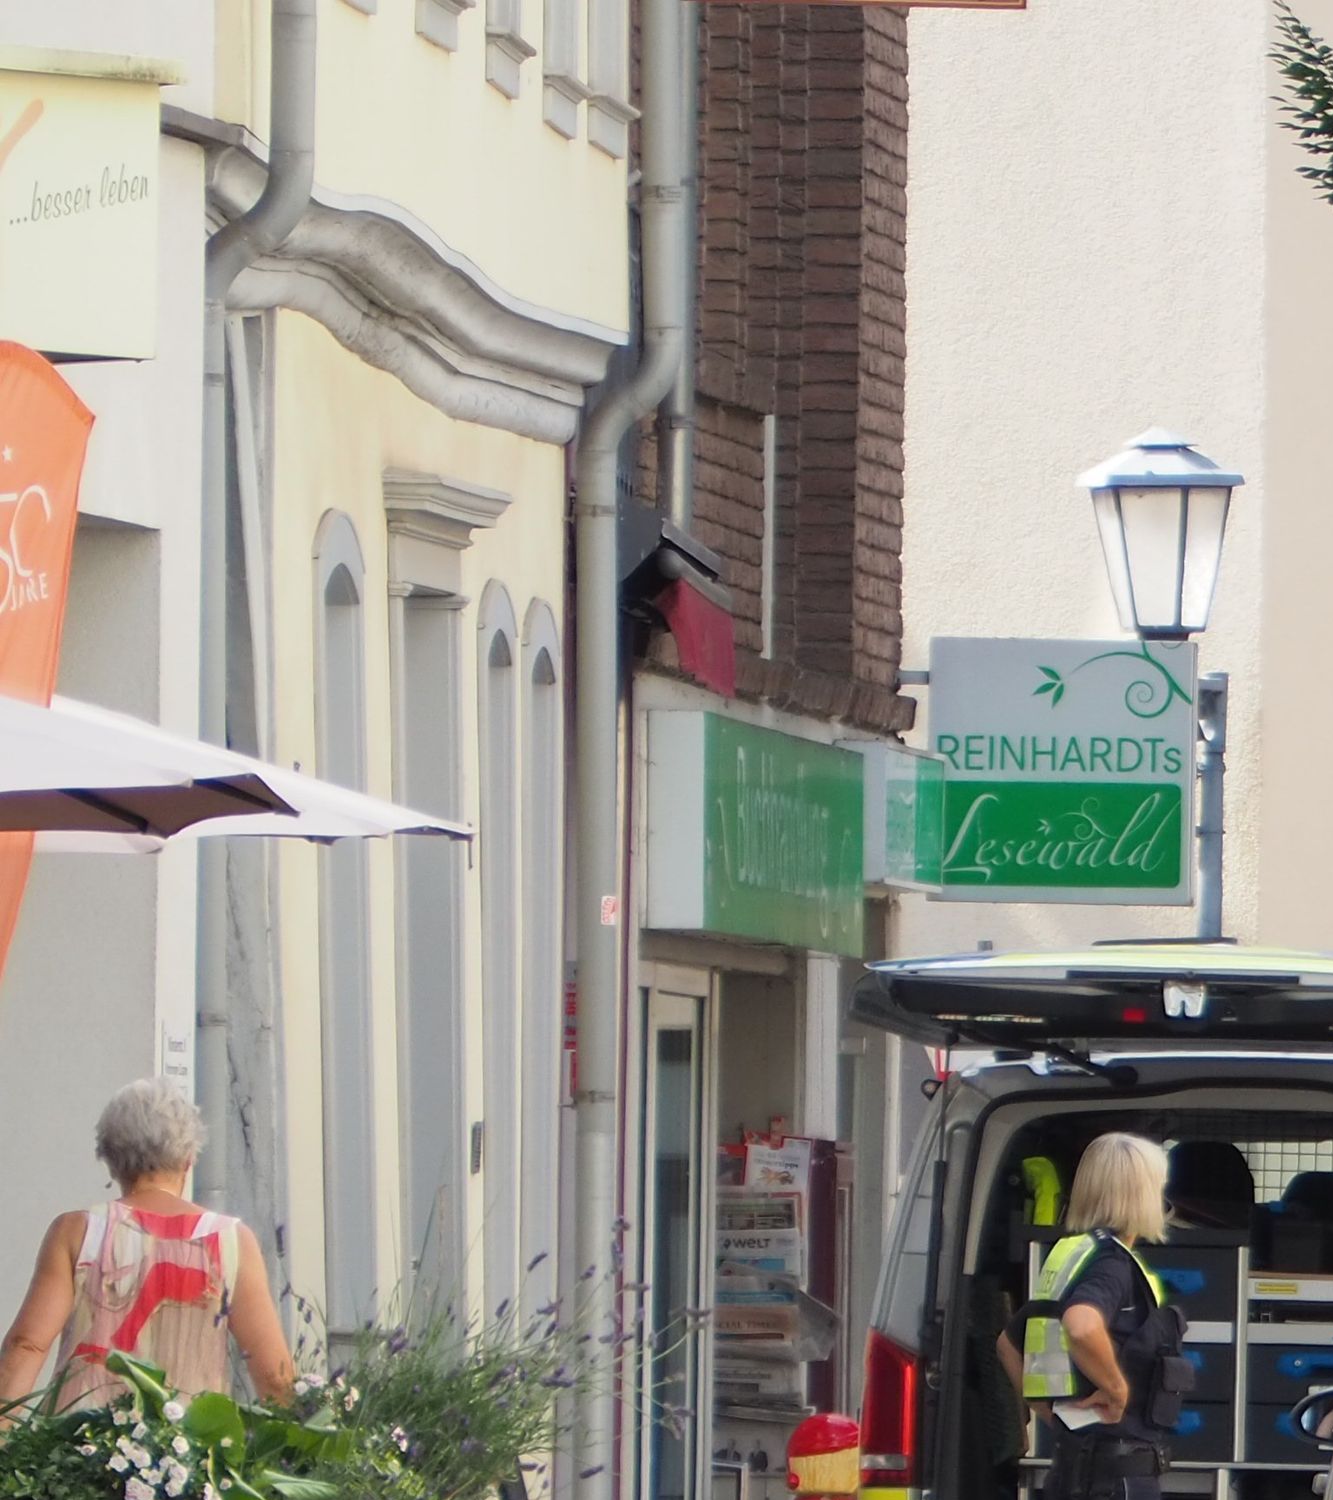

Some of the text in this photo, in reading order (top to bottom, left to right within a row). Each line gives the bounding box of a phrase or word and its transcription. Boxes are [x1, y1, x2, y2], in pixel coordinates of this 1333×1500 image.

[99, 163, 148, 208] leben
[936, 734, 1183, 774] REINHARDTs
[942, 791, 1182, 883] Lesewald
